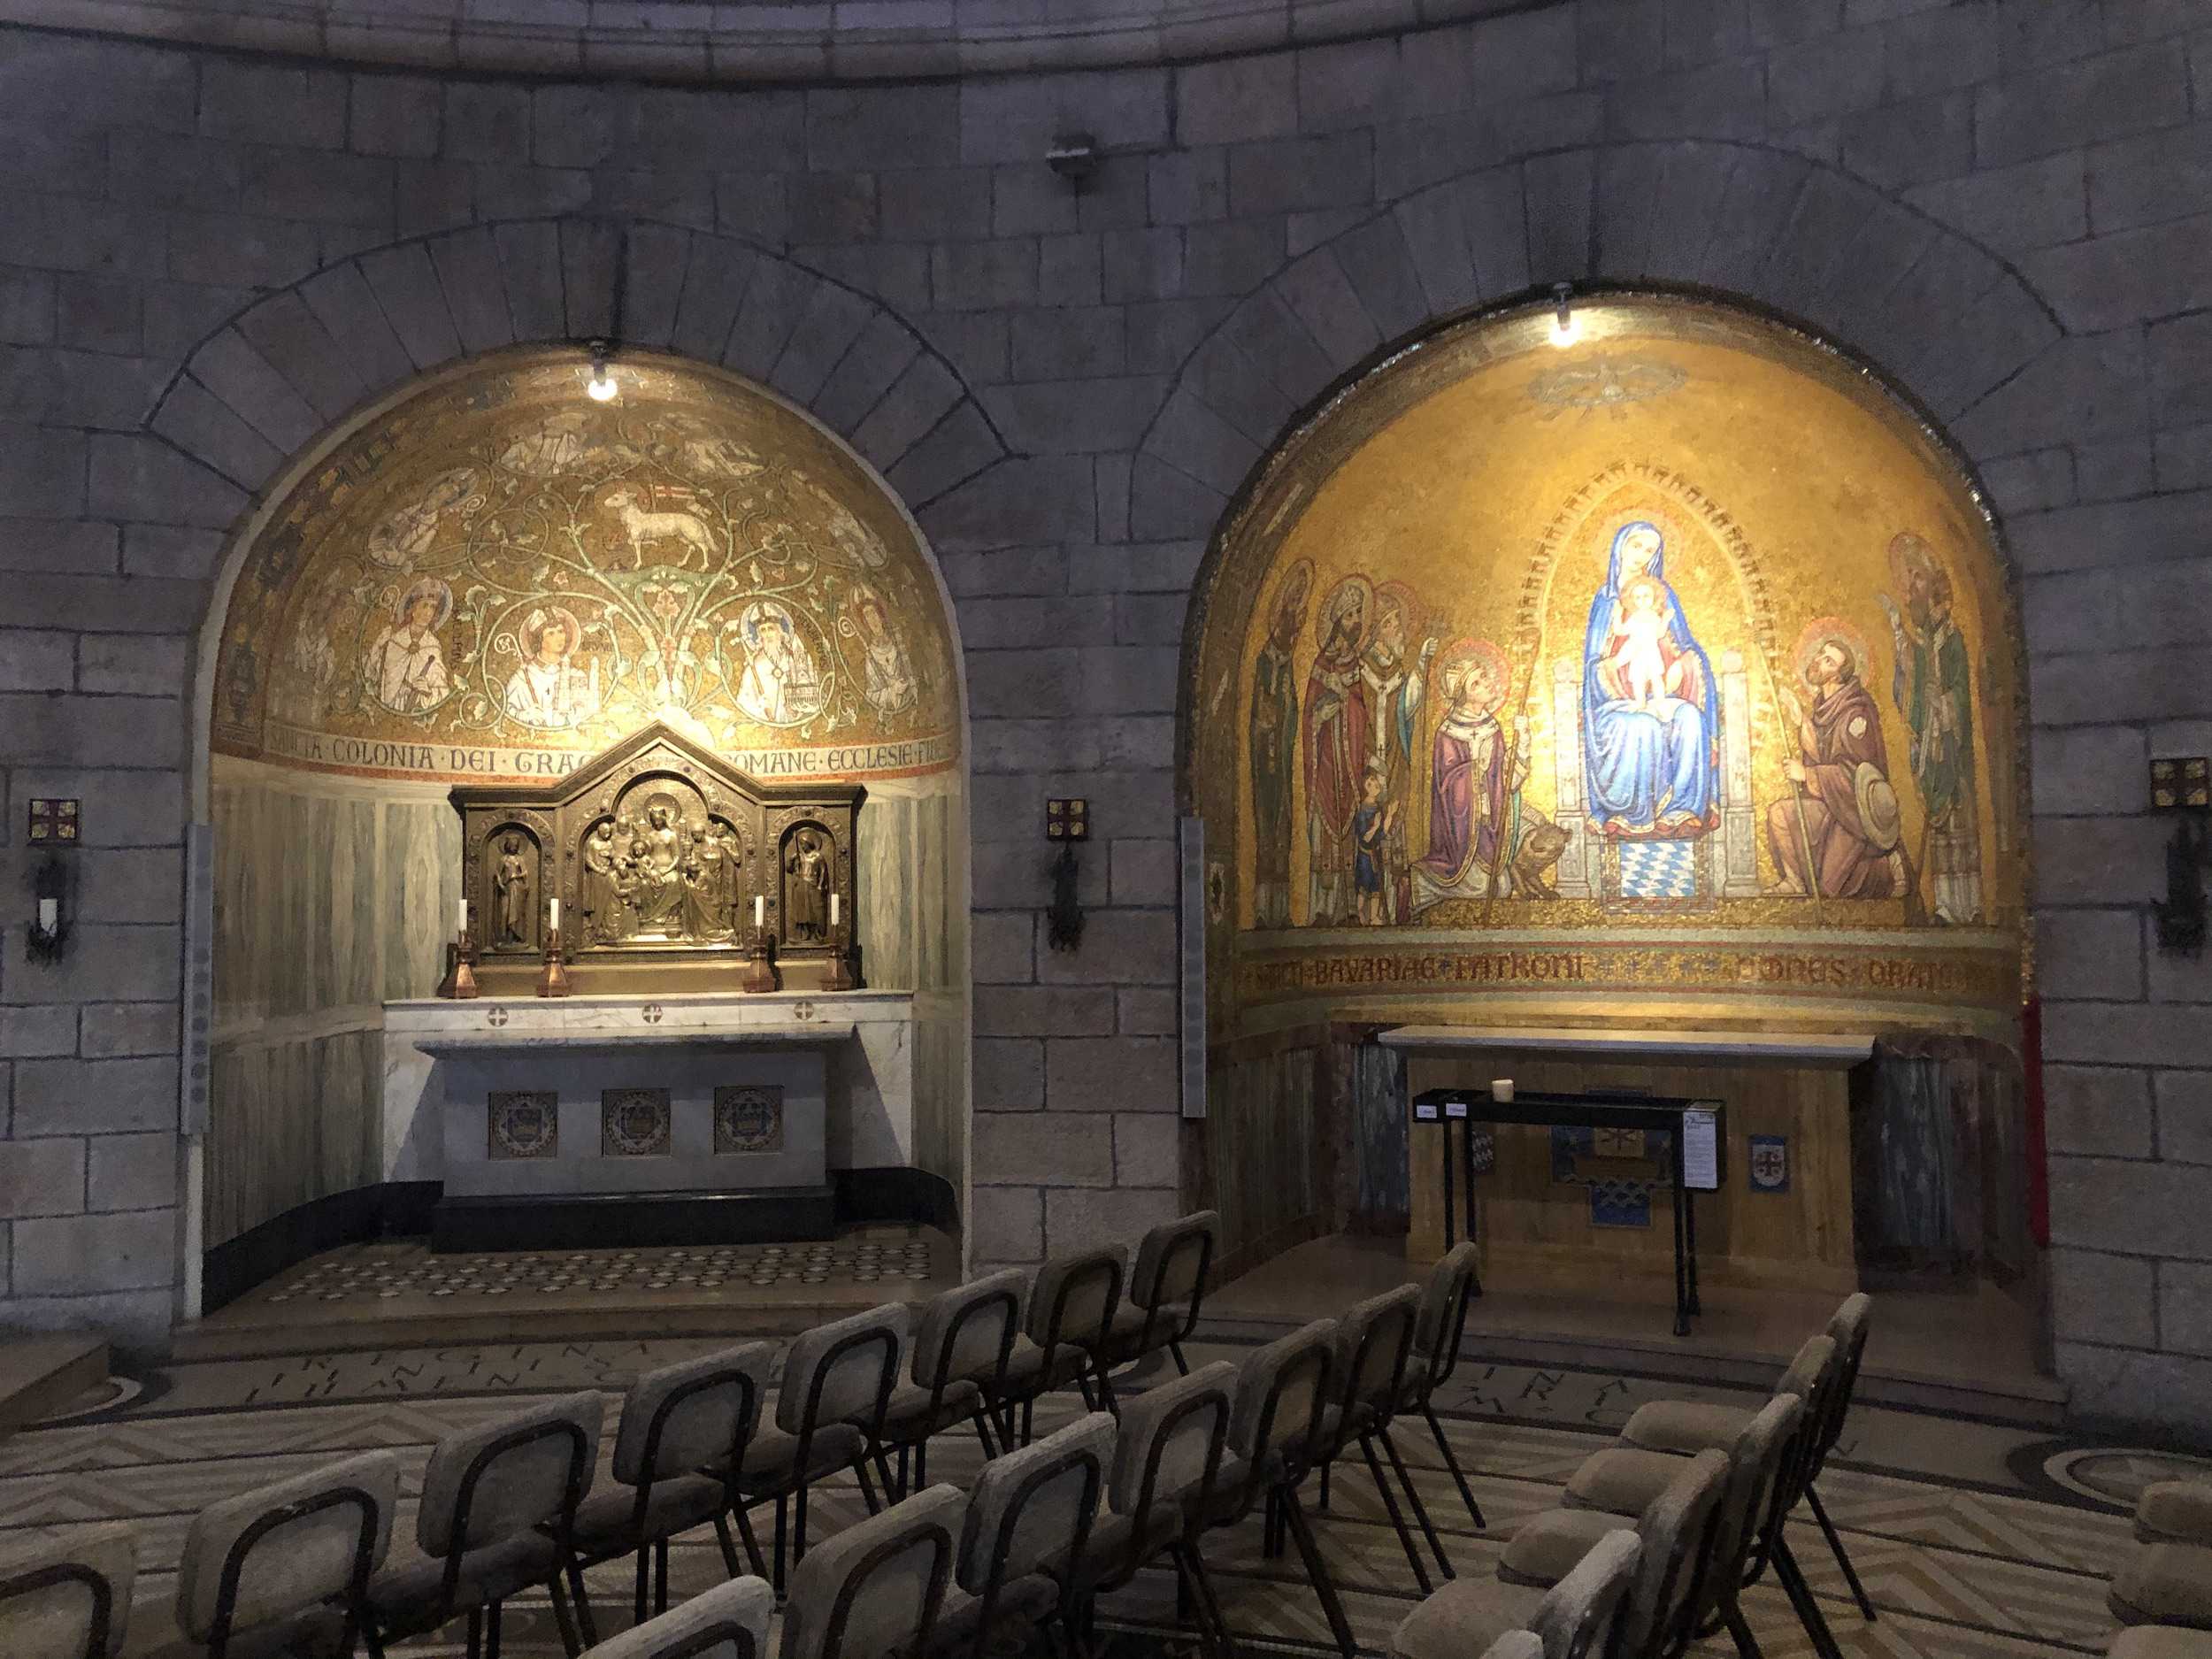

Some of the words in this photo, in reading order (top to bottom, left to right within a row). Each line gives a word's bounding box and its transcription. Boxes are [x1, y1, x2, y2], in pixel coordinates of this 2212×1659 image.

[334, 738, 434, 769] COLONIA
[450, 749, 495, 772] DEI
[827, 743, 912, 771] ECCLESIE
[1456, 953, 1585, 981] PATRONI
